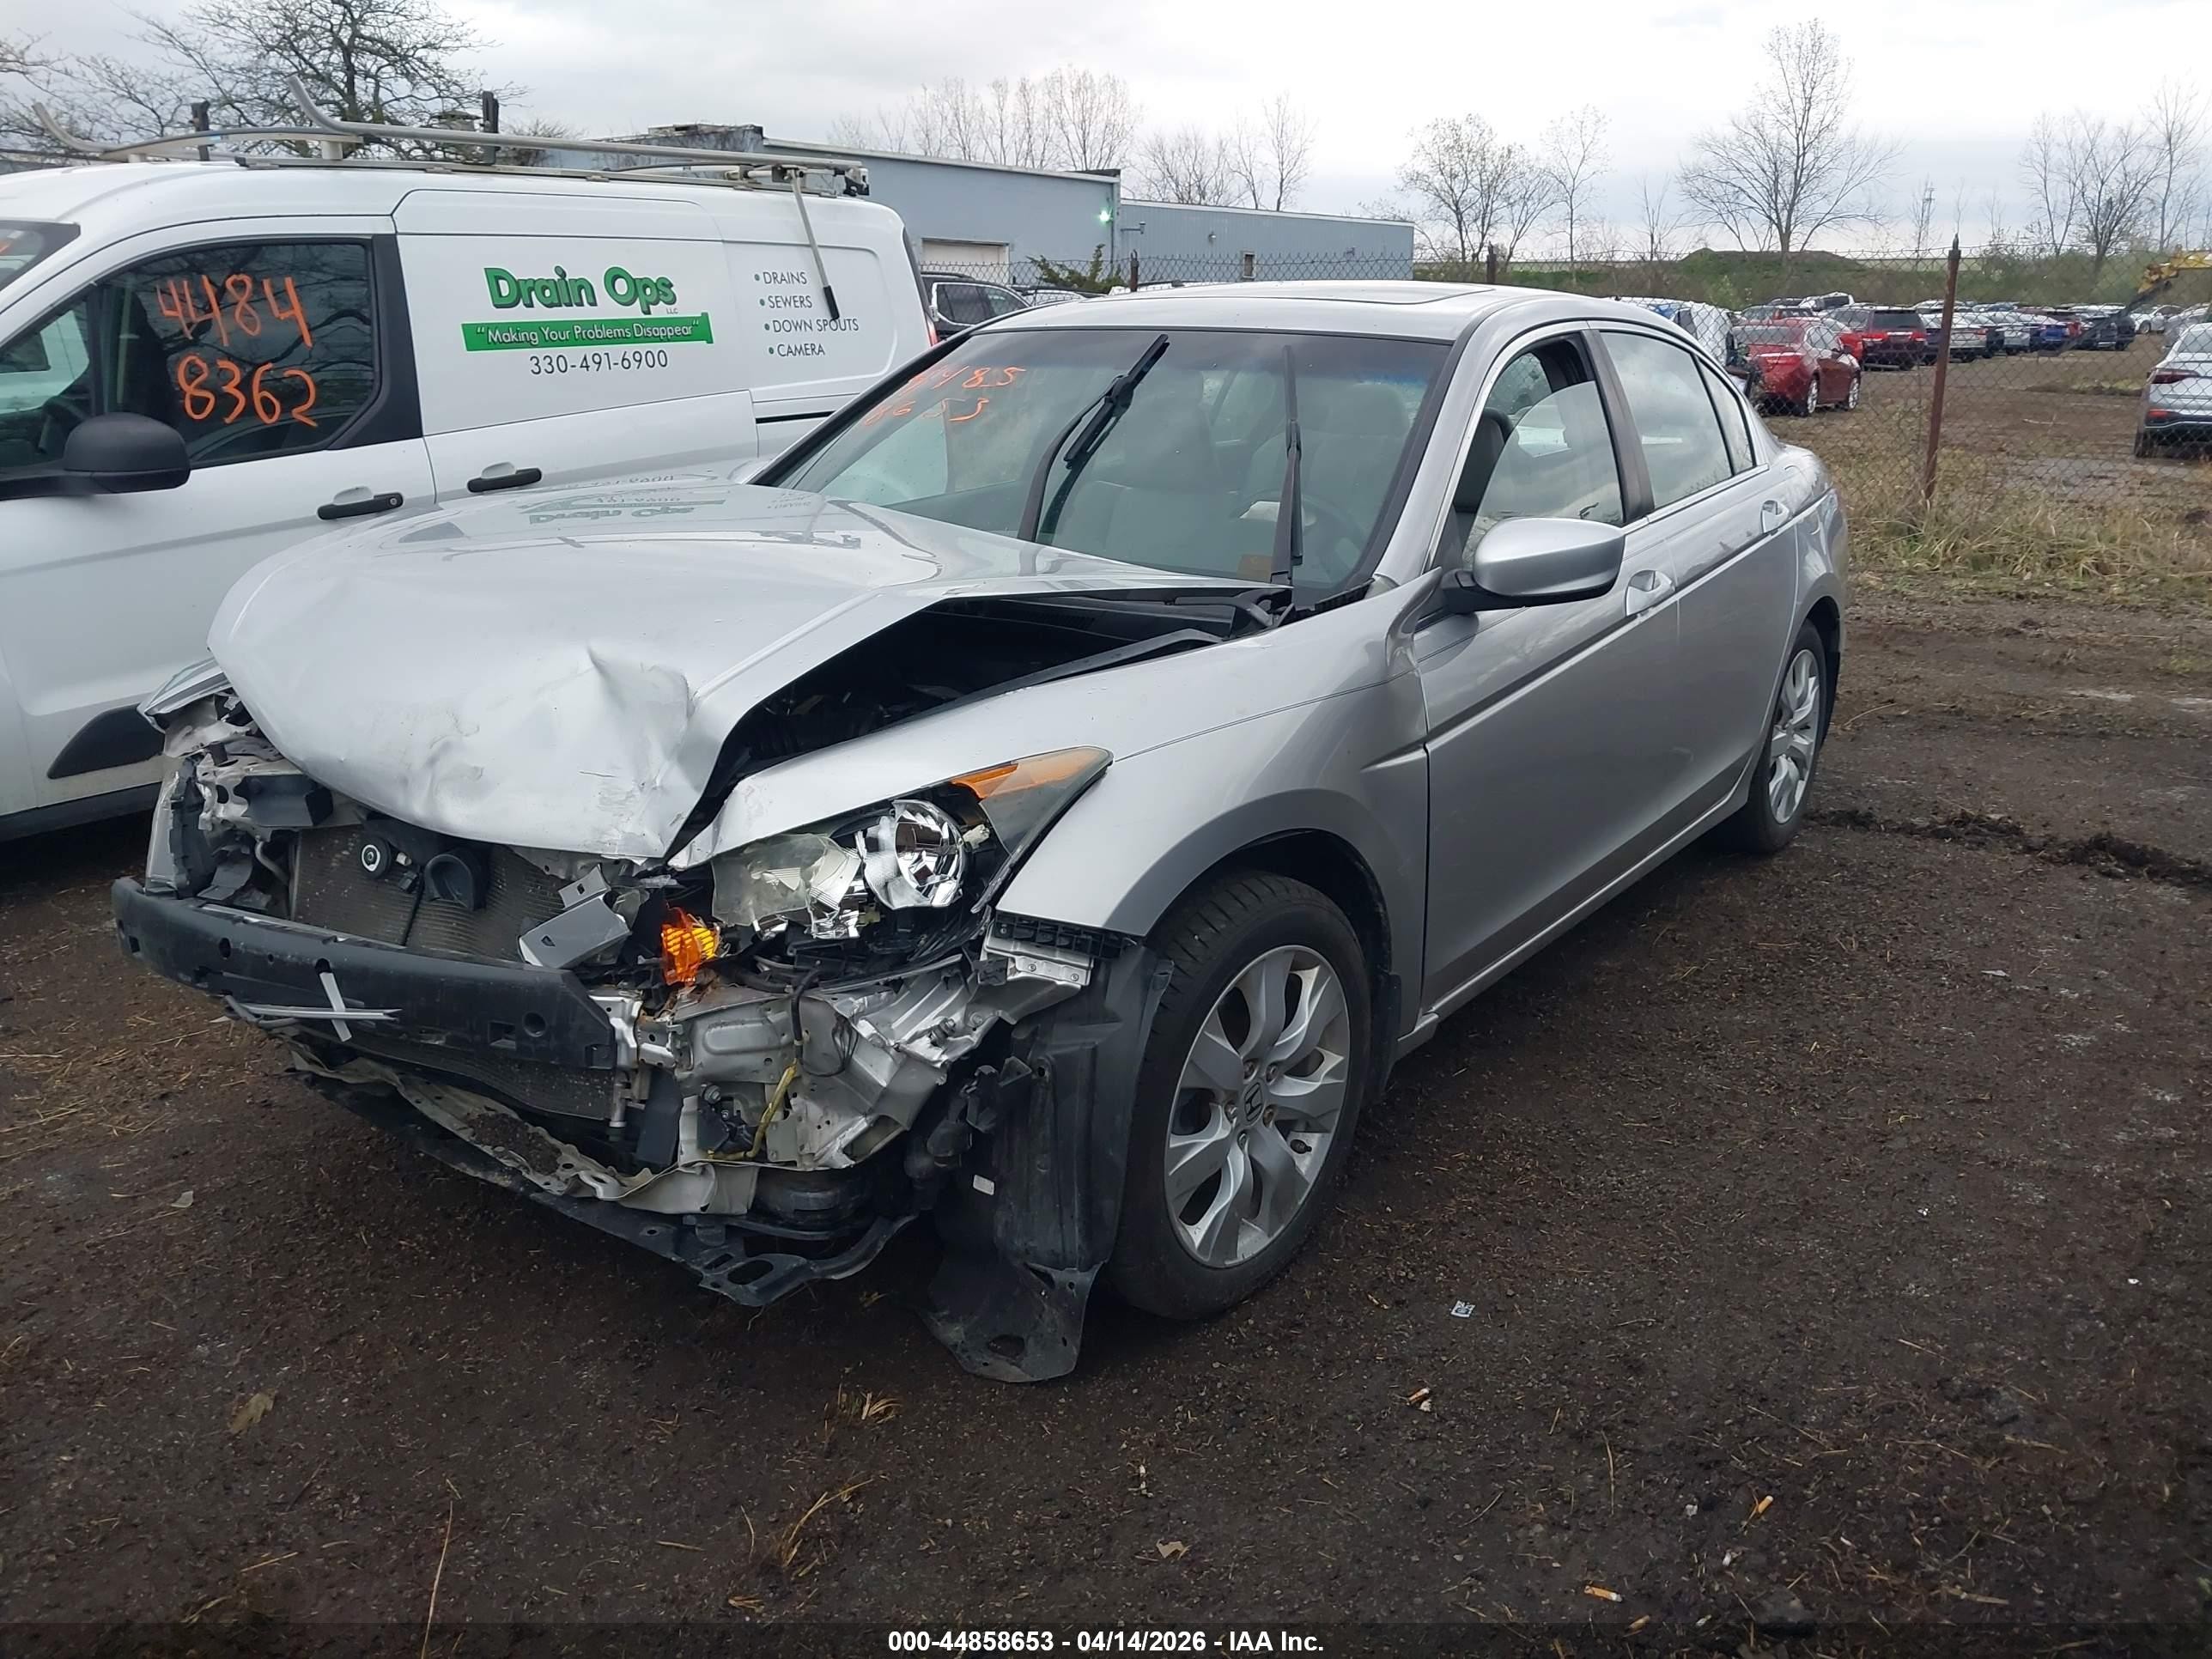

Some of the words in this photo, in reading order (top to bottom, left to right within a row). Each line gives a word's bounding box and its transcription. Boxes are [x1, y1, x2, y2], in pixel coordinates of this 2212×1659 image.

[763, 271, 807, 284] DRAINS
[484, 265, 598, 308] Drain
[604, 266, 677, 314] Ops
[768, 295, 812, 308] SEWERS
[157, 274, 313, 349] 4484
[542, 326, 570, 340] Your
[574, 325, 631, 338] Problems
[772, 319, 813, 332] DOWN
[816, 318, 859, 331] SPOUTS
[777, 343, 825, 356] CAMERA
[530, 349, 668, 374] 330-491-6900
[178, 353, 317, 428] 8362
